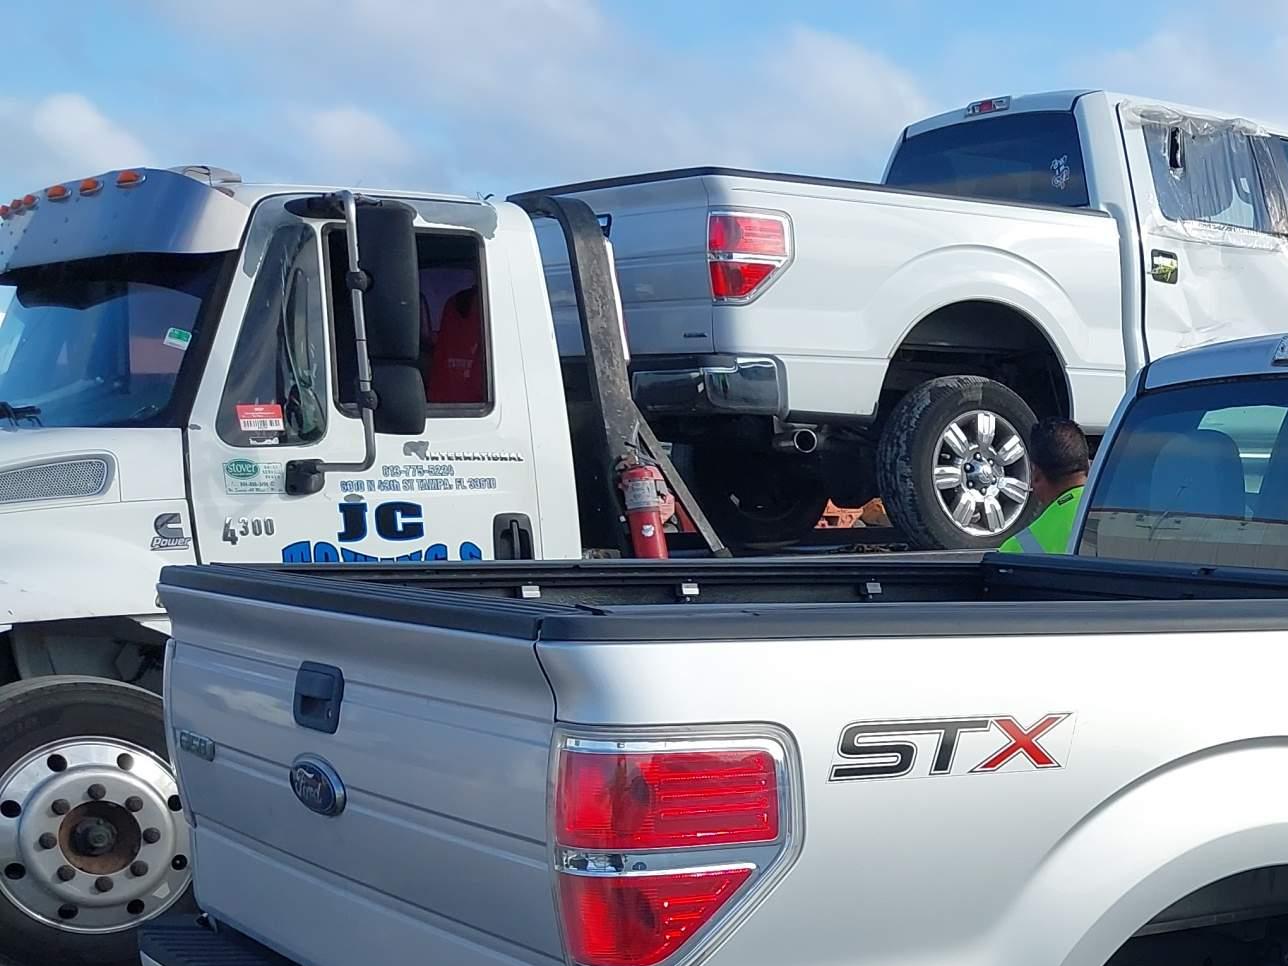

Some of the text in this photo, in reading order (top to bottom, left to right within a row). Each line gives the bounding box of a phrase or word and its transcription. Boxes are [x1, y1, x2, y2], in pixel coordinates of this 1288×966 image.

[424, 451, 524, 462] INTERNATIONAL
[402, 478, 415, 491] ST
[455, 477, 467, 489] FL
[222, 516, 275, 546] 4300
[337, 501, 425, 543] JC
[151, 536, 192, 548] Power
[827, 711, 1073, 783] STX
[293, 767, 321, 801] Ford
